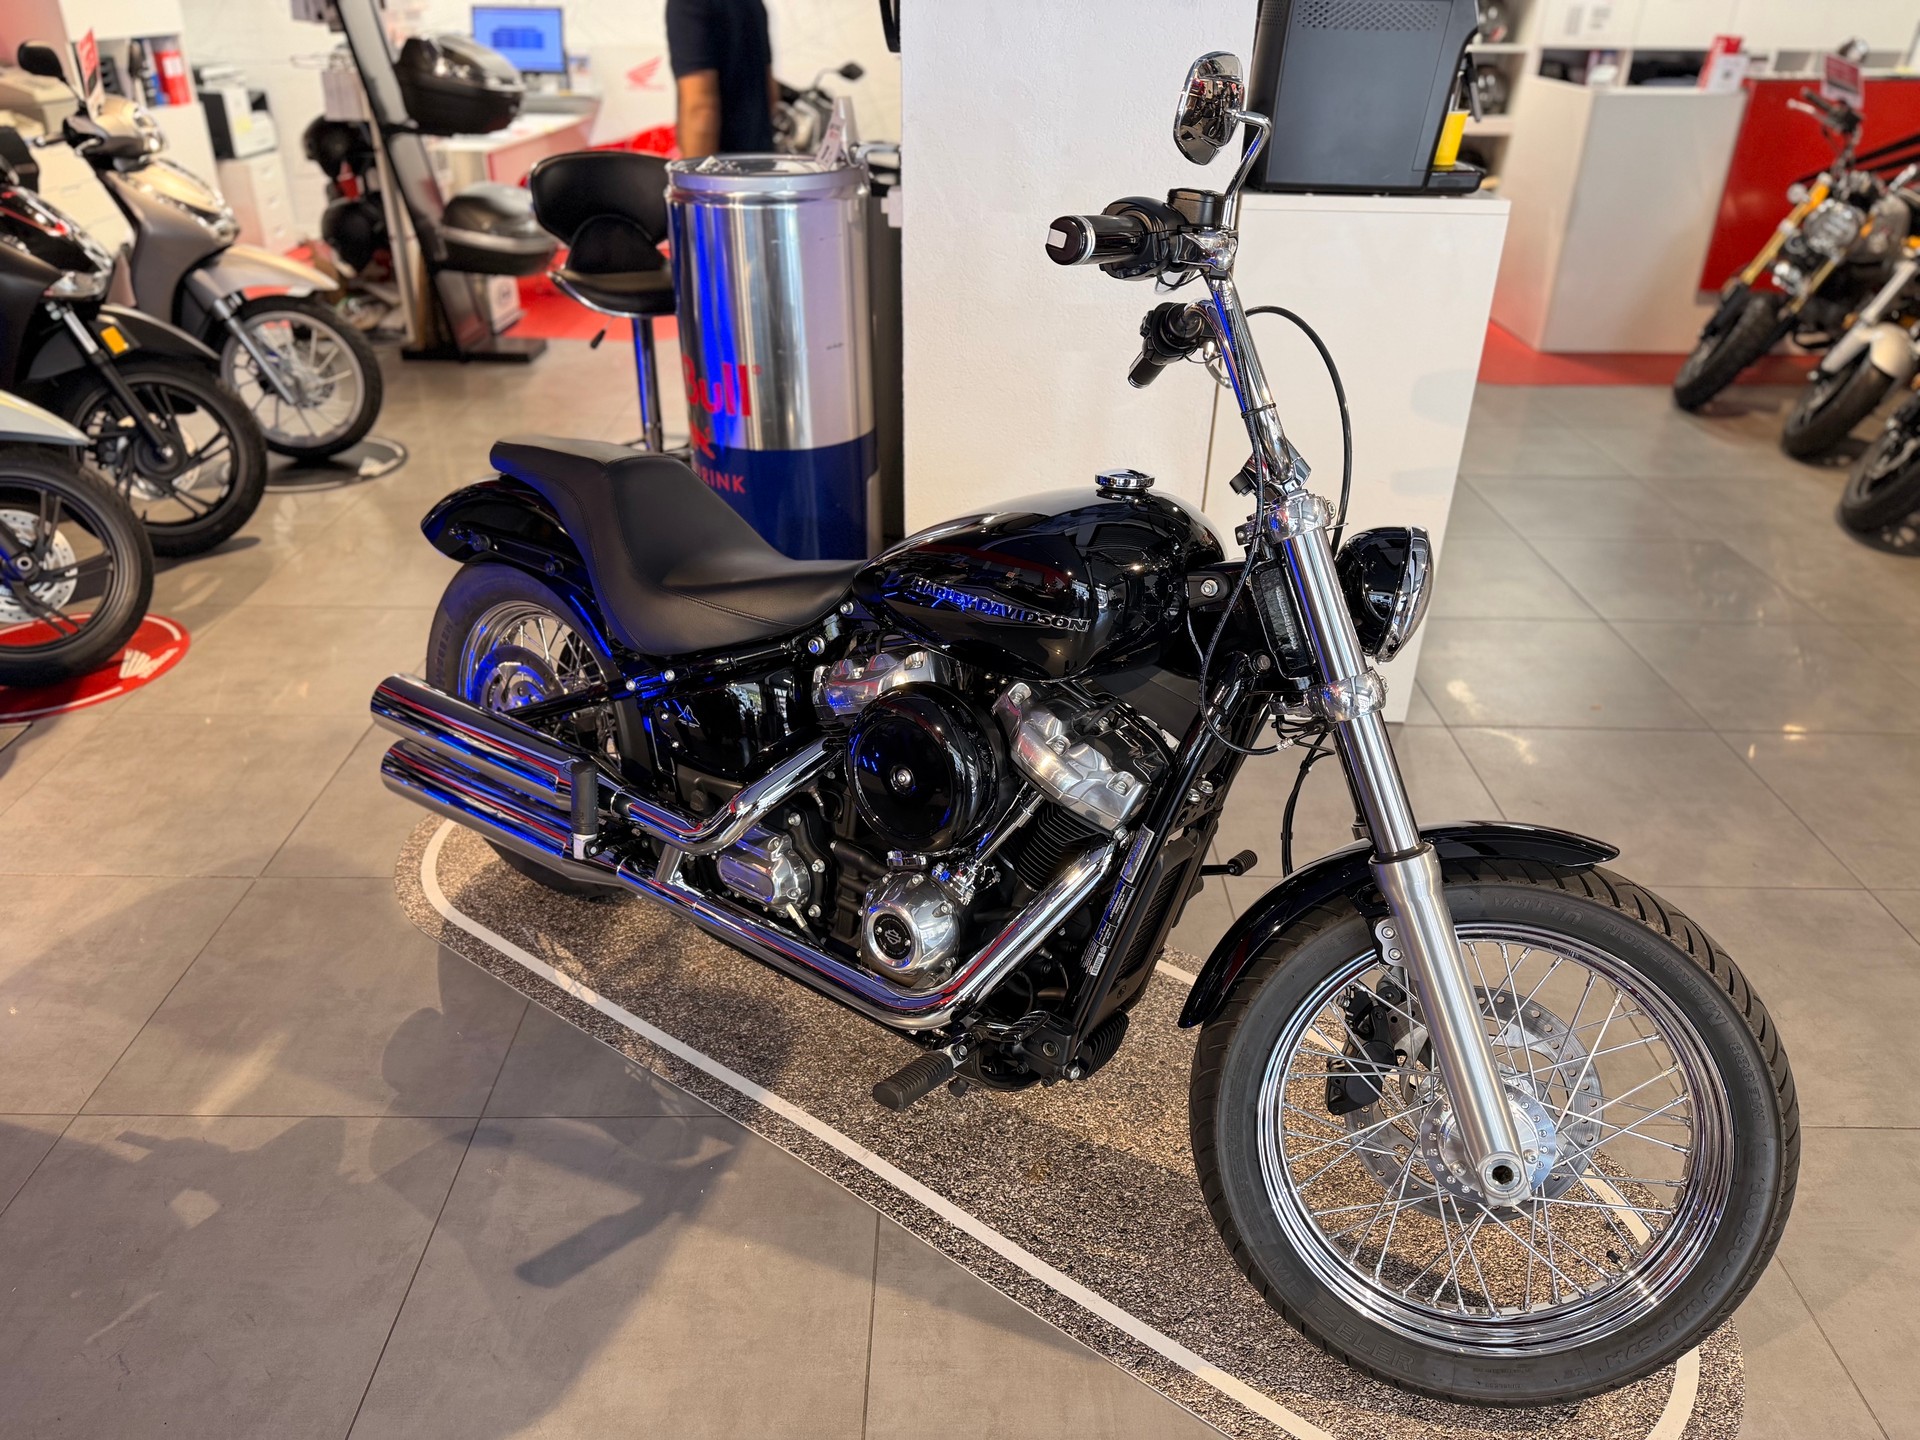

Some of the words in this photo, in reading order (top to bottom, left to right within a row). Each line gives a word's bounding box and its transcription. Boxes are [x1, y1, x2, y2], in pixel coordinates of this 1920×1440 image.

[1493, 895, 1584, 926] ULTRA
[1603, 922, 1728, 1024] MARATHON
[1266, 1257, 1417, 1373] METZELER
